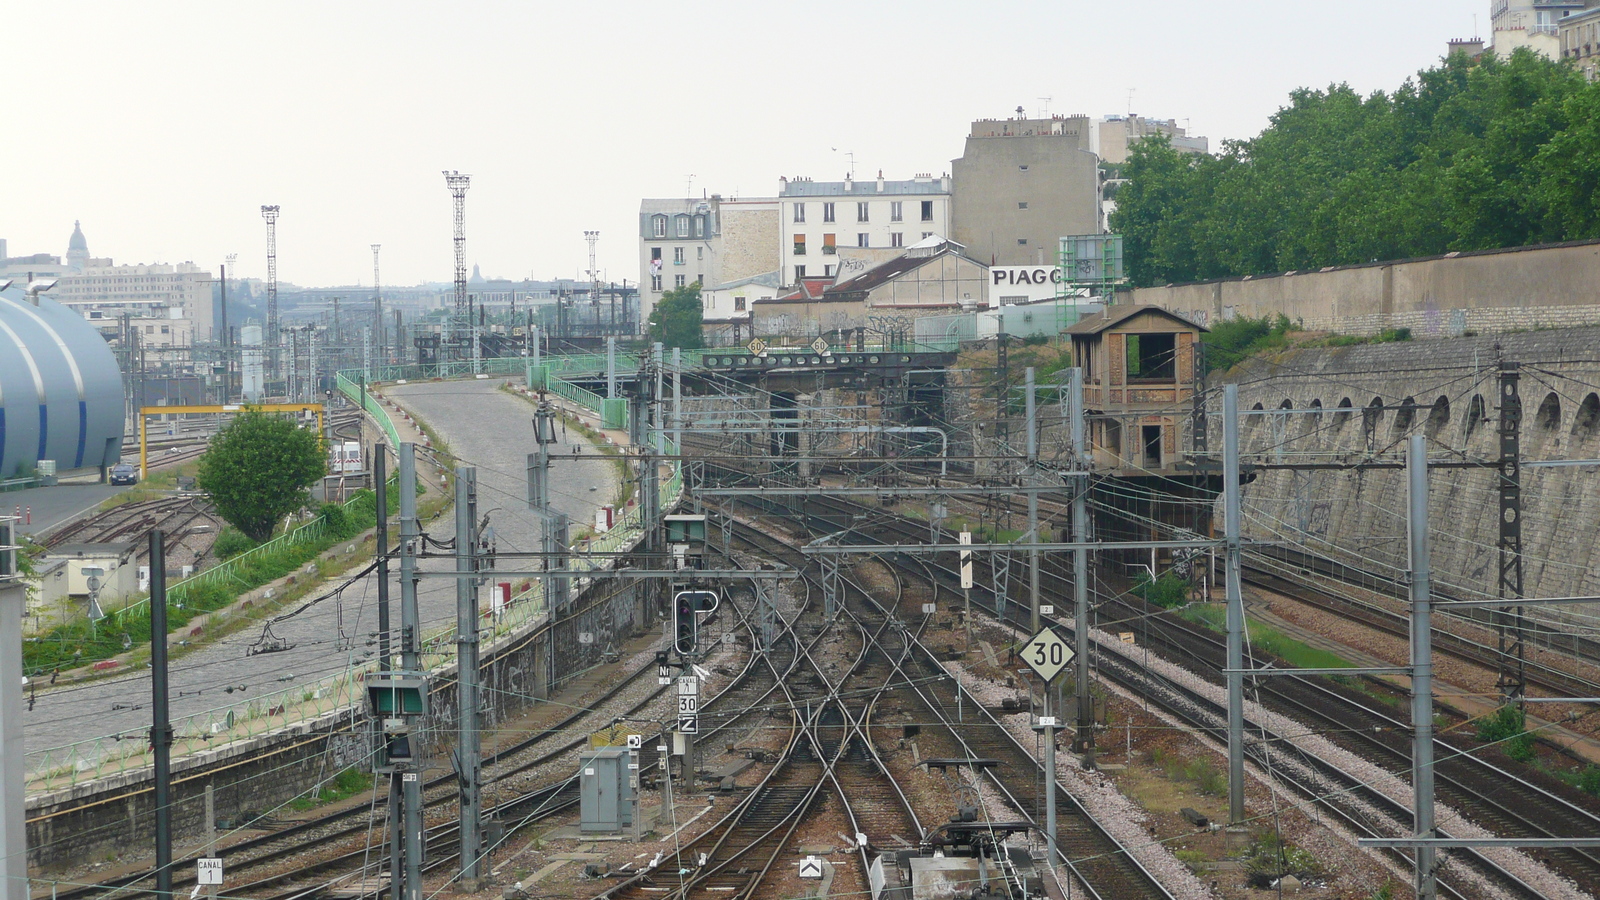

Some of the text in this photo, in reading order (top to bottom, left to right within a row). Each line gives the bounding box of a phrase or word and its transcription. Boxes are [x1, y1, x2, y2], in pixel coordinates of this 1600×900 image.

[750, 342, 761, 351] 60
[814, 341, 825, 350] 60
[725, 633, 731, 643] 2
[1033, 642, 1063, 666] 30
[680, 698, 696, 711] 30
[681, 716, 695, 731] Z
[198, 861, 222, 869] CANAL
[207, 870, 213, 882] 1
